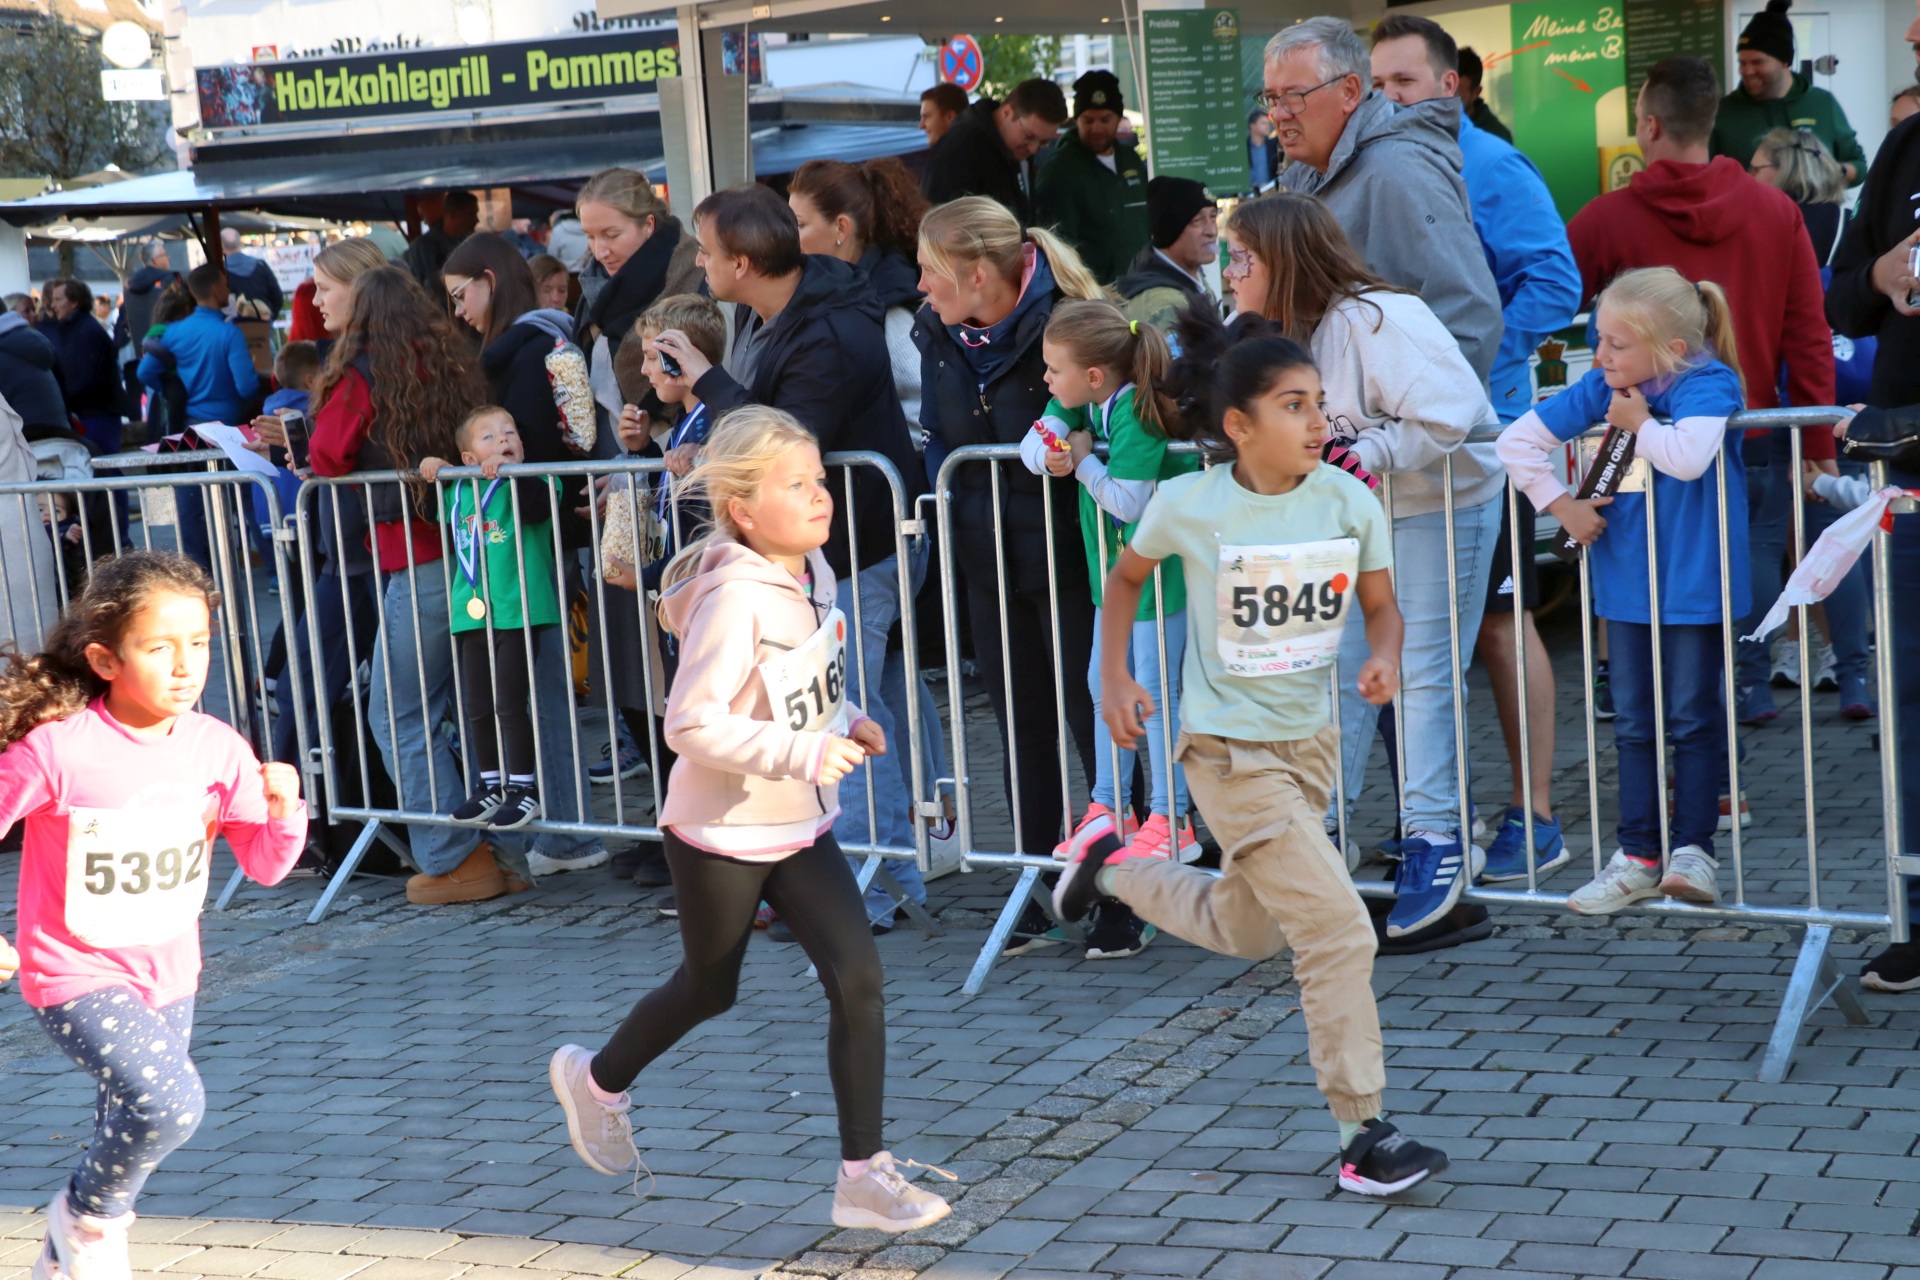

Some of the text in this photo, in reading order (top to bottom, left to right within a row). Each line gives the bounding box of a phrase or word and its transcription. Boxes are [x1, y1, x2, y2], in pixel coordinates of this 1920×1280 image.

[1148, 18, 1180, 29] Preisliste
[1522, 15, 1586, 40] Meine
[1543, 35, 1625, 66] mein B
[274, 46, 678, 111] Holzkohlegrill - Pommes
[1611, 431, 1633, 462] FEND
[1595, 462, 1617, 494] NEUE
[1231, 580, 1343, 628] 5849
[1260, 662, 1290, 671] VOSS
[784, 646, 845, 732] 5169
[84, 839, 206, 896] 5392
